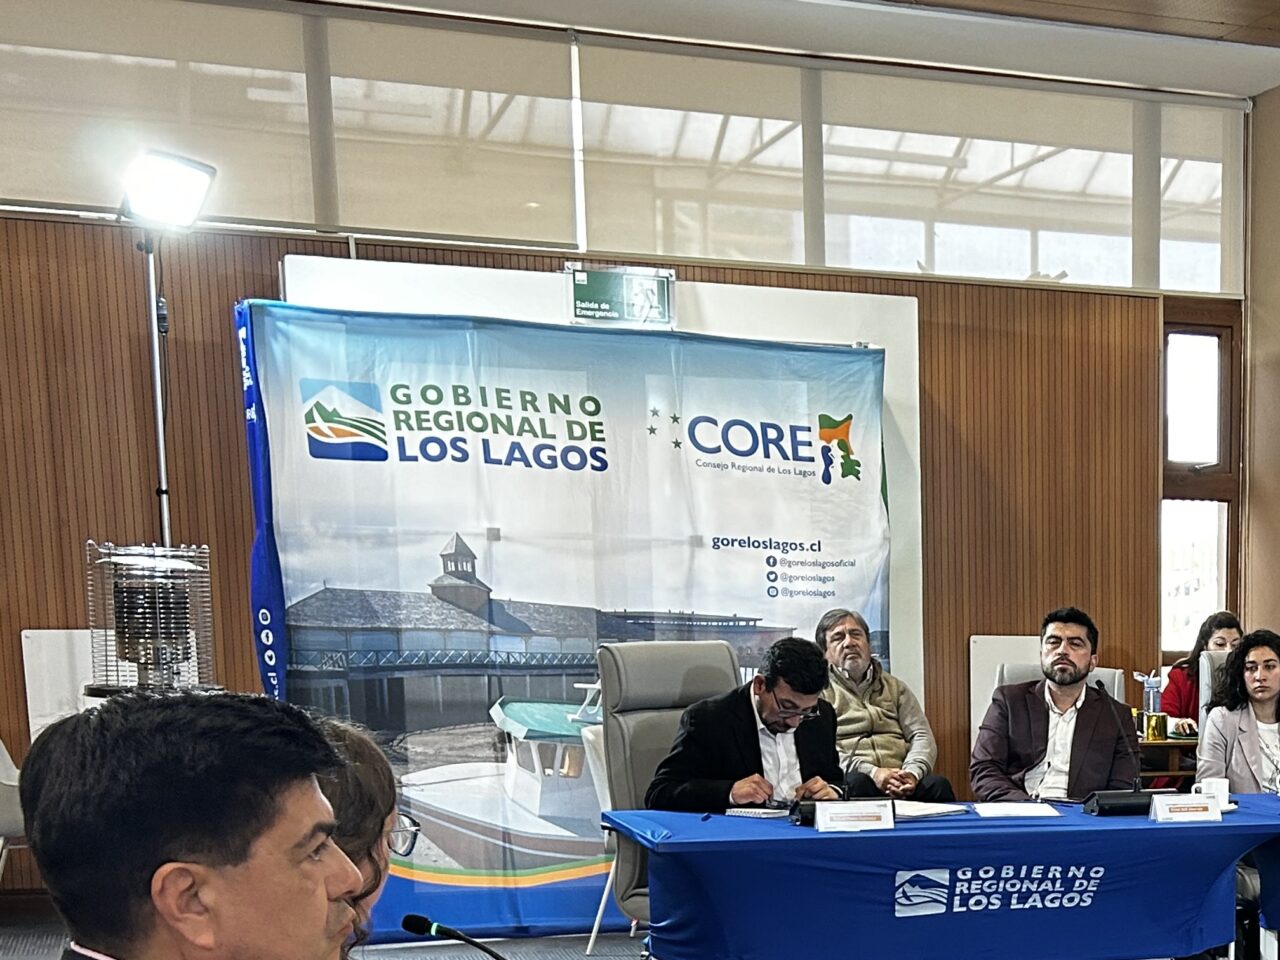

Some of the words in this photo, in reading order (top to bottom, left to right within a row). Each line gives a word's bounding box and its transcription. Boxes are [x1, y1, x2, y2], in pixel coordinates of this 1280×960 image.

[576, 301, 598, 309] Salida
[390, 384, 601, 417] GOBIERNO
[393, 410, 556, 439] REGIONAL
[566, 420, 606, 442] DE
[688, 416, 815, 462] CORE
[397, 436, 469, 462] LOS
[482, 438, 608, 472] LAGOS
[696, 459, 728, 470] Consejo
[732, 463, 764, 473] Regional
[778, 467, 791, 475] Los
[794, 468, 816, 478] Lagos
[712, 537, 821, 554] goreloslagos.cl
[957, 866, 1104, 879] GOBIERNO
[955, 879, 1065, 894] REGIONAL
[1073, 879, 1100, 891] DE
[953, 893, 1002, 912] LOS
[1010, 893, 1093, 909] LAGOS
